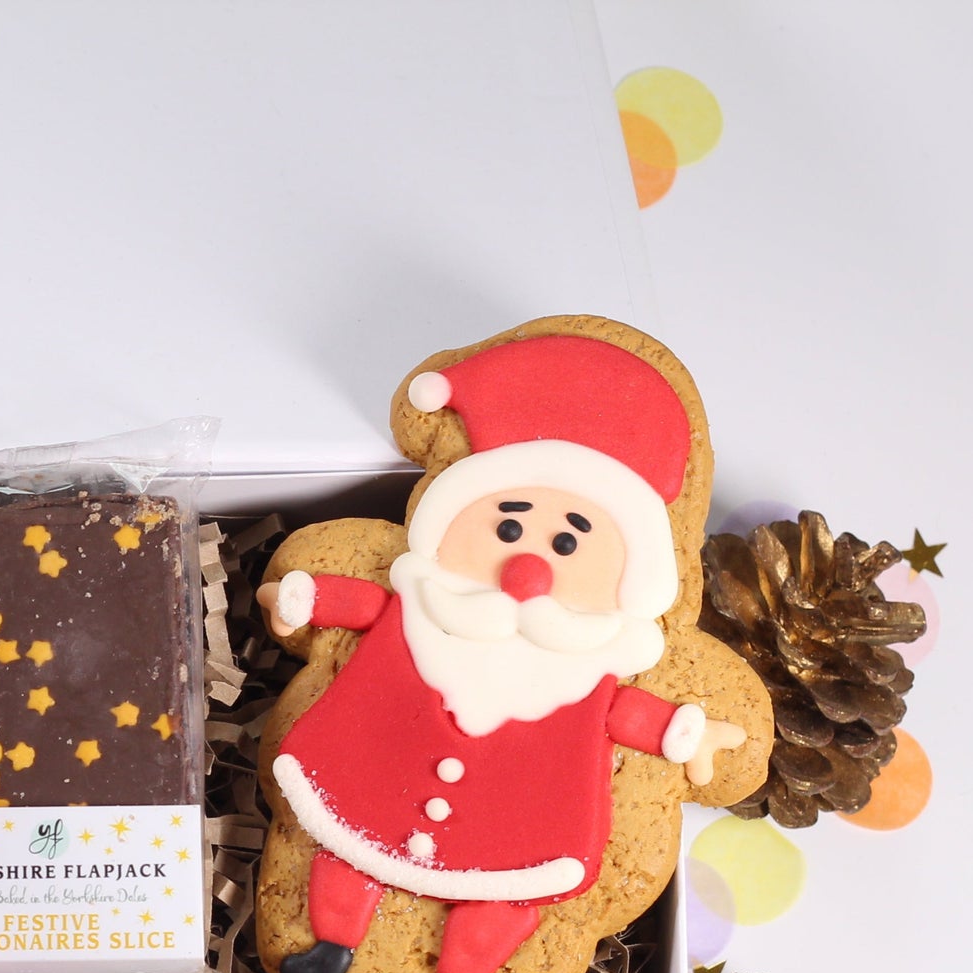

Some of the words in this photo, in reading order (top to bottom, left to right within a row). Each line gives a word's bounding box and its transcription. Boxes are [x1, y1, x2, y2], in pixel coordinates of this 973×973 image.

[63, 864, 167, 881] FLAPJACK
[3, 914, 100, 932] FESTIVE
[110, 932, 176, 949] SLICE
